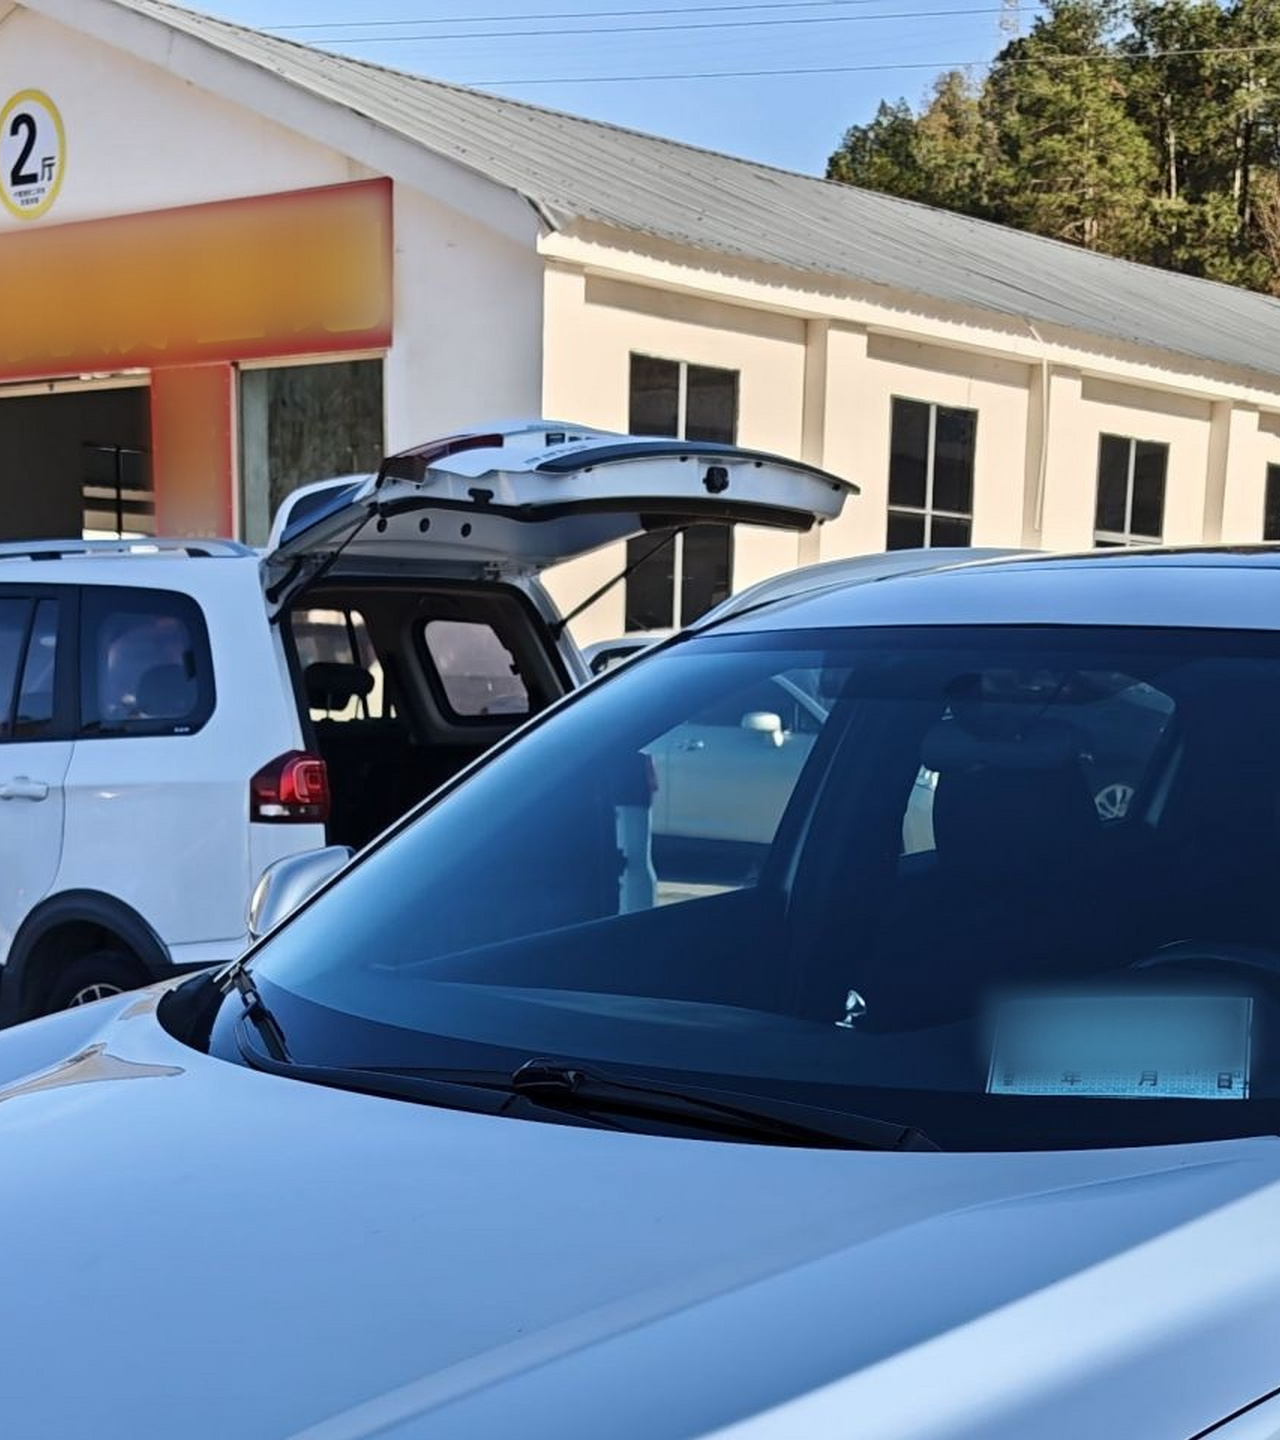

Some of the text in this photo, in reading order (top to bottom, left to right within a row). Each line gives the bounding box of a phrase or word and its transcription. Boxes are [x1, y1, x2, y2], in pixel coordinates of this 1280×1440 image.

[1061, 1070, 1233, 1089] 年 月 日
